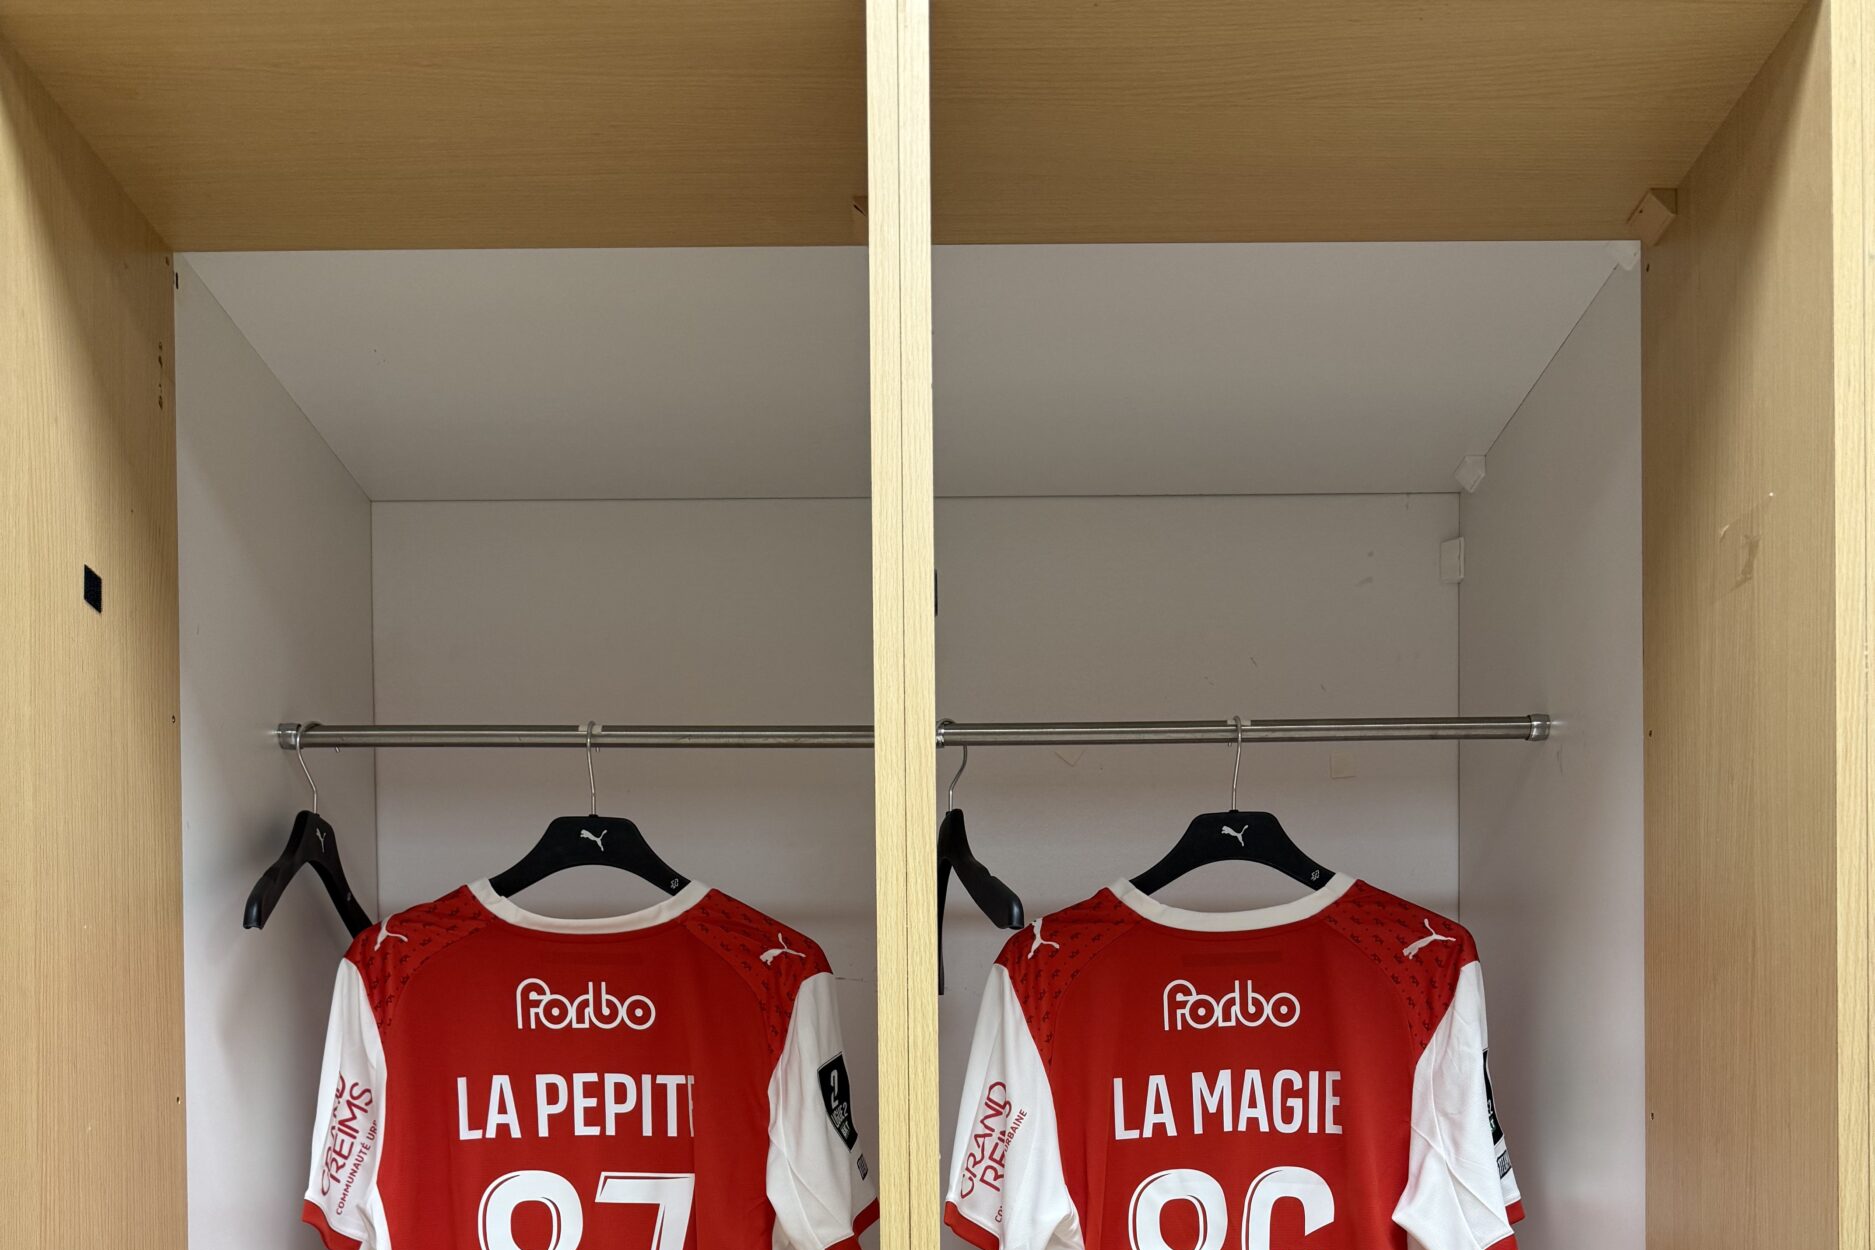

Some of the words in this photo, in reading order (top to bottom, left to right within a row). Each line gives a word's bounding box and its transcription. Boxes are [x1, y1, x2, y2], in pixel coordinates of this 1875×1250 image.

[457, 1074, 522, 1141] LA
[1113, 1074, 1178, 1141] LA
[1191, 1069, 1343, 1136] MAGIE
